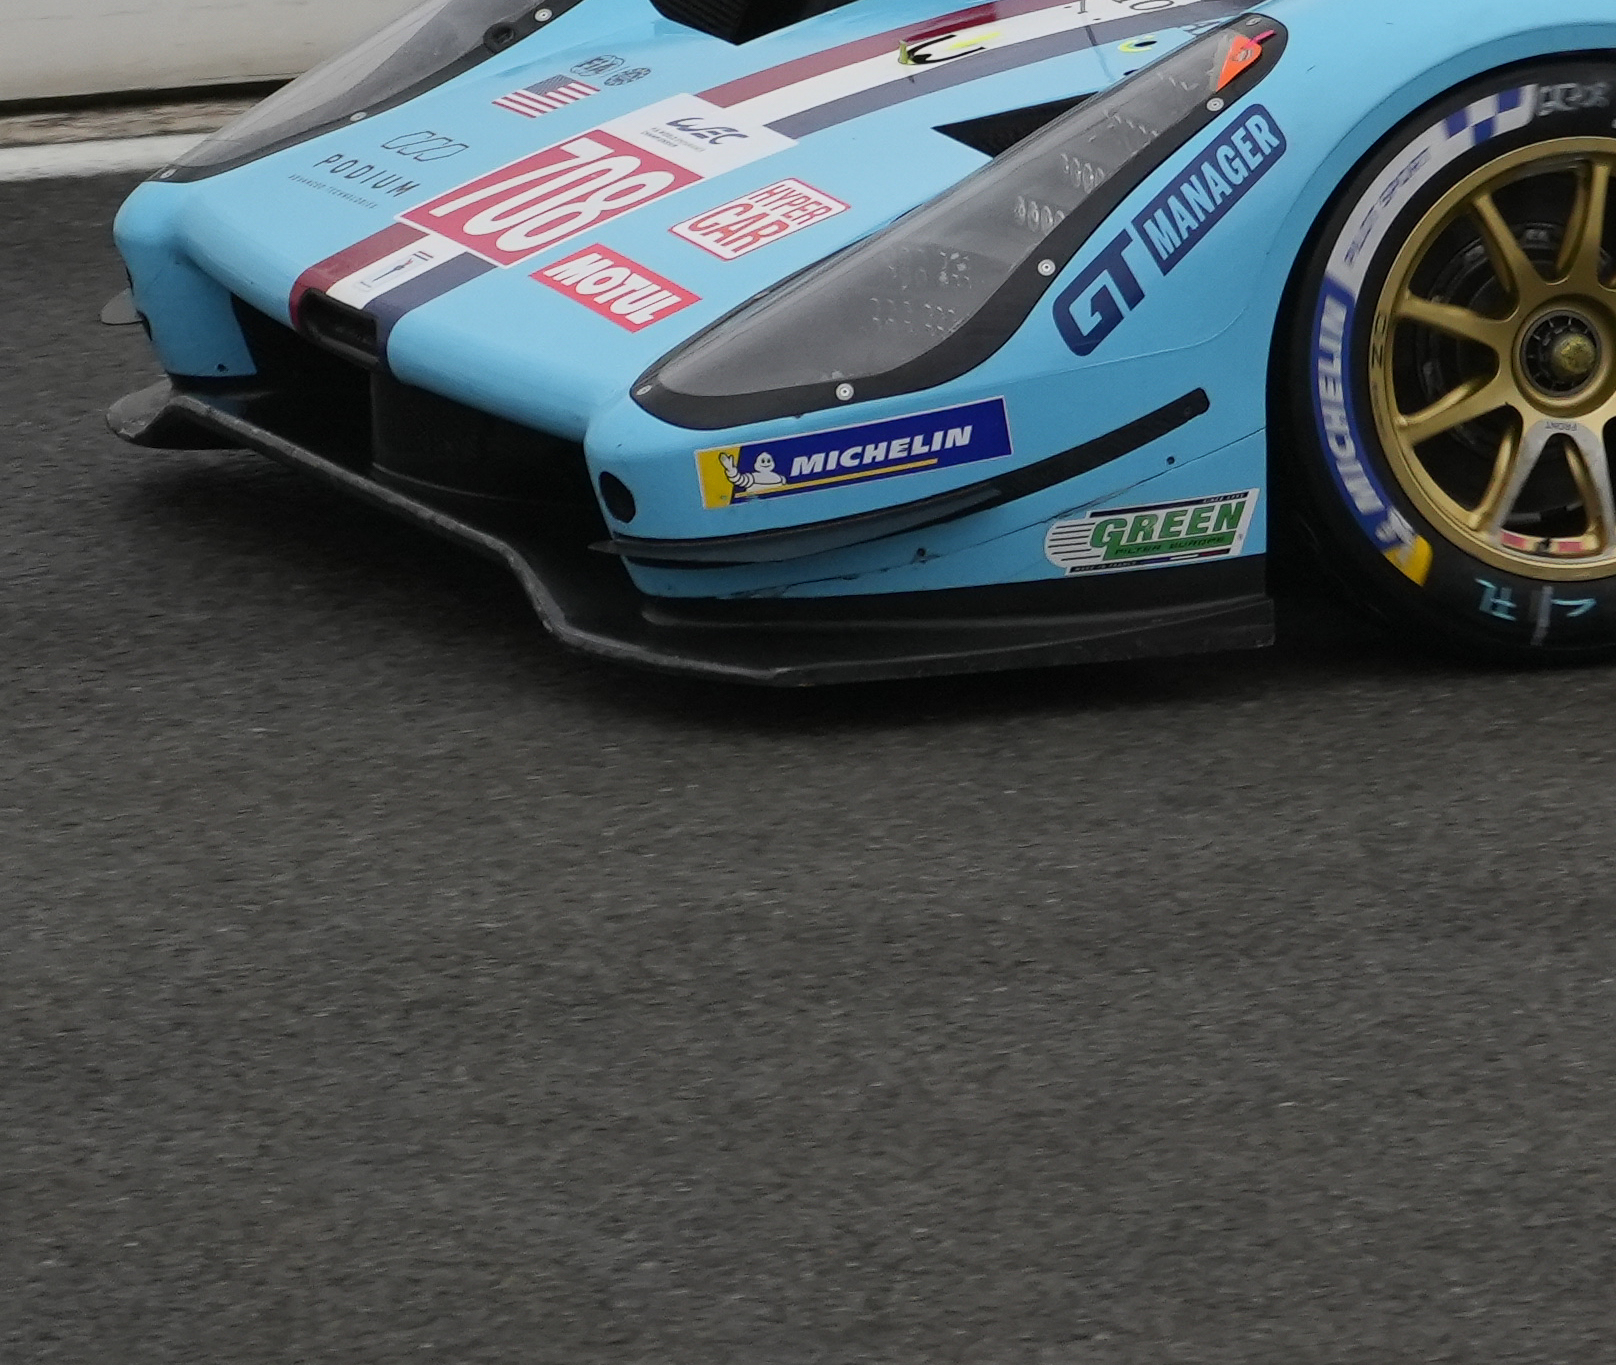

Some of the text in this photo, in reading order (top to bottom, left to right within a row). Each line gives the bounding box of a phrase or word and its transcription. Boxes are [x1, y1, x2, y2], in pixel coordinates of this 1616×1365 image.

[313, 153, 420, 198] PODIUM
[428, 139, 679, 252] 708
[688, 203, 790, 254] CAR
[748, 184, 833, 226] HYPER
[1052, 114, 1281, 357] GT MANAGER
[545, 253, 685, 325] MOTUL
[1318, 297, 1387, 516] MICHELIN
[789, 424, 974, 478] MICHELIN
[1090, 501, 1247, 548] GREEN
